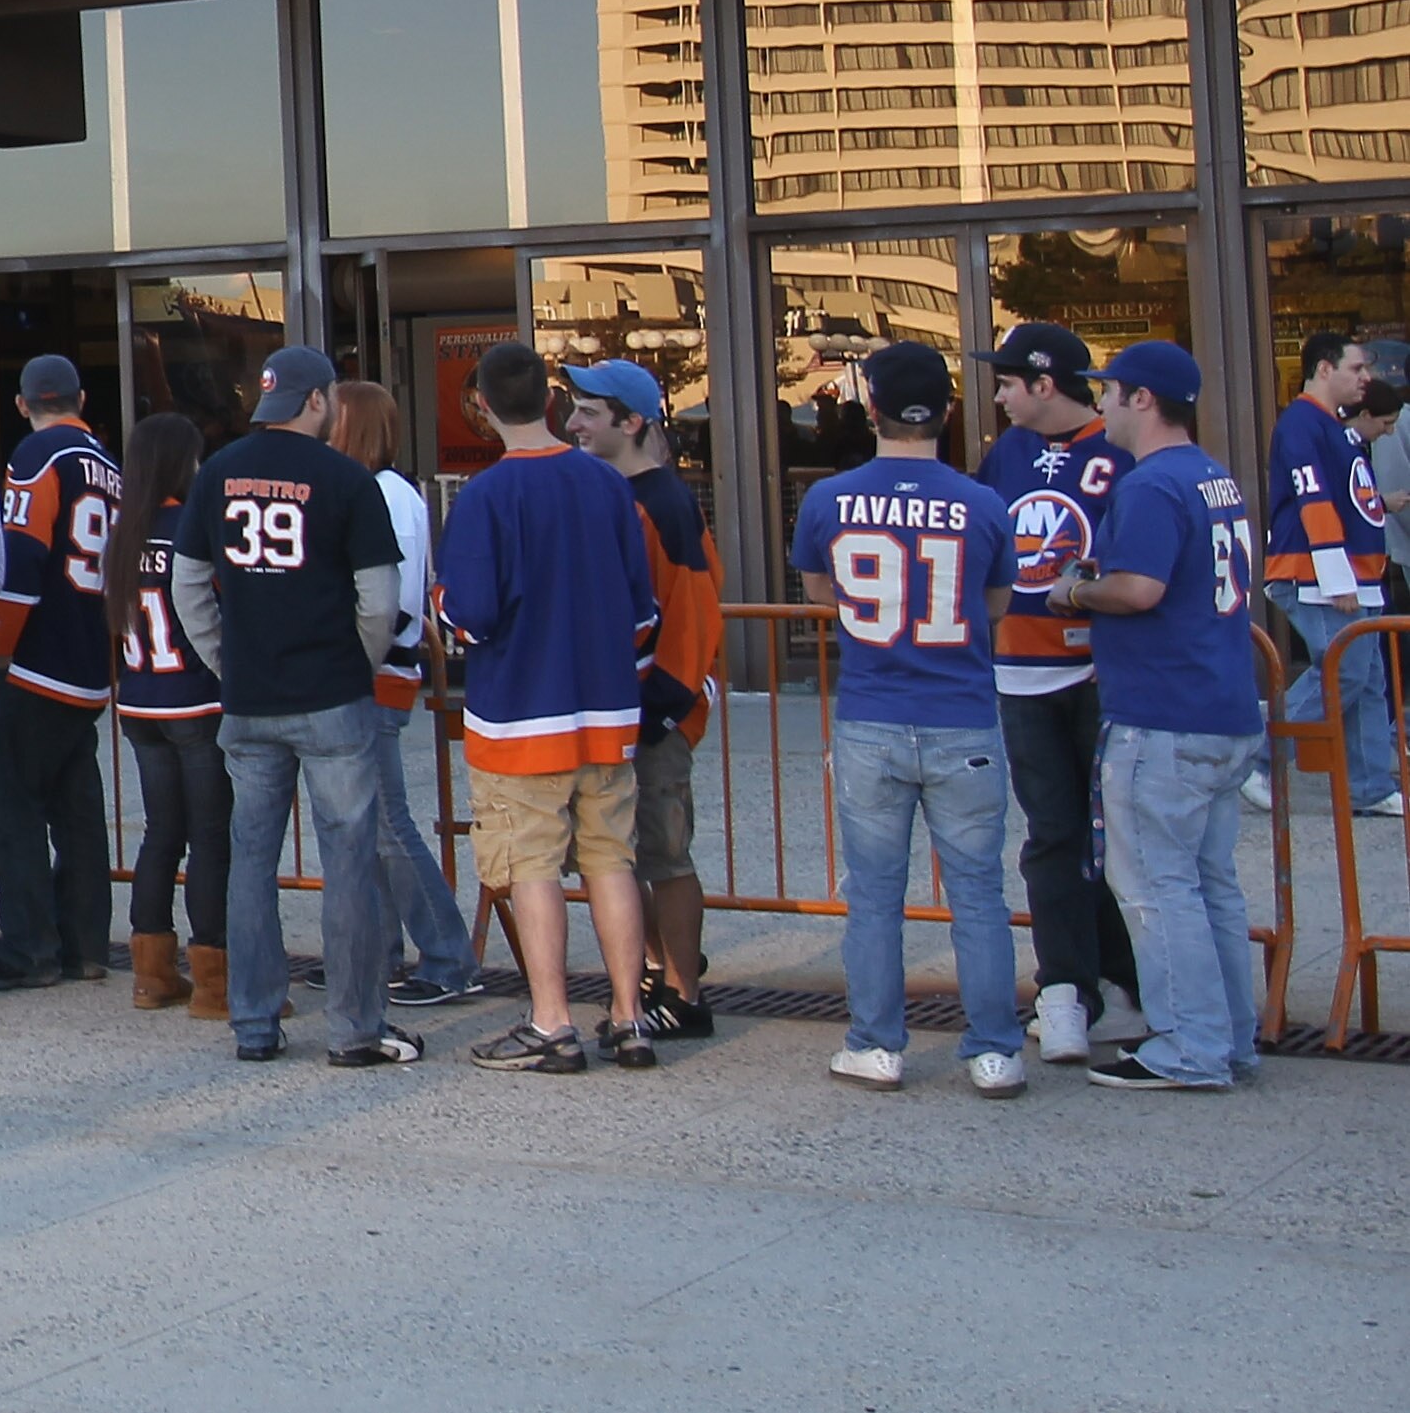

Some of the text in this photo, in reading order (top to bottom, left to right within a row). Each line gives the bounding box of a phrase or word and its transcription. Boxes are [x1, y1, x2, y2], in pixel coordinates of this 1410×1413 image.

[224, 478, 311, 502] DIPIETRO
[1080, 456, 1115, 496] C
[836, 495, 967, 530] TAVARES
[224, 499, 304, 567] 39
[829, 530, 970, 648] 91
